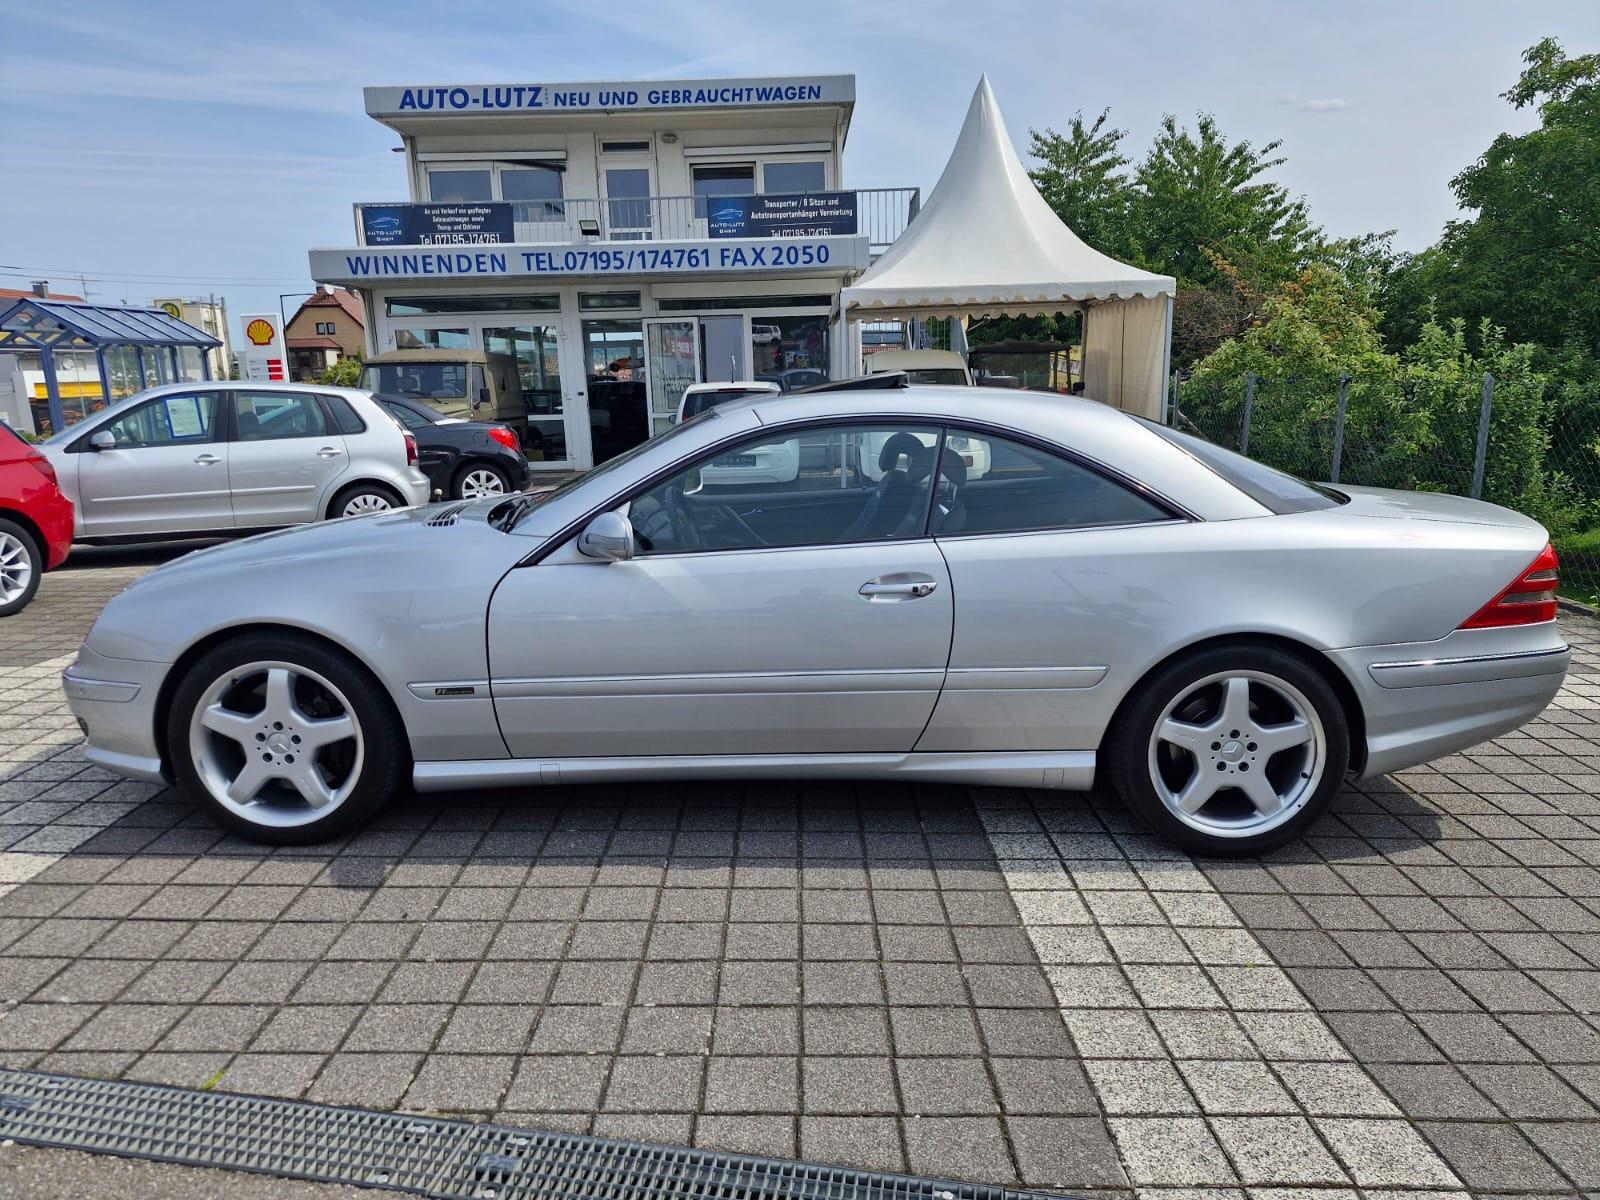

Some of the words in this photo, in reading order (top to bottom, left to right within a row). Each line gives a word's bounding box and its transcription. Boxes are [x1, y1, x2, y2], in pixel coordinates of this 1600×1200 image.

[399, 87, 543, 110] AUTO-LUTZ
[554, 92, 590, 106] NEU
[599, 91, 638, 106] UND
[647, 85, 822, 105] GEBRAUCHTWAGEN
[764, 200, 798, 209] Transporter
[808, 198, 826, 206] Sitzer
[828, 198, 839, 206] und
[819, 208, 853, 217] Vermietung
[347, 254, 506, 276] WINNENDEN
[521, 248, 710, 272] TEL.07195/174761
[720, 247, 766, 267] FAX
[771, 244, 829, 266] 2050
